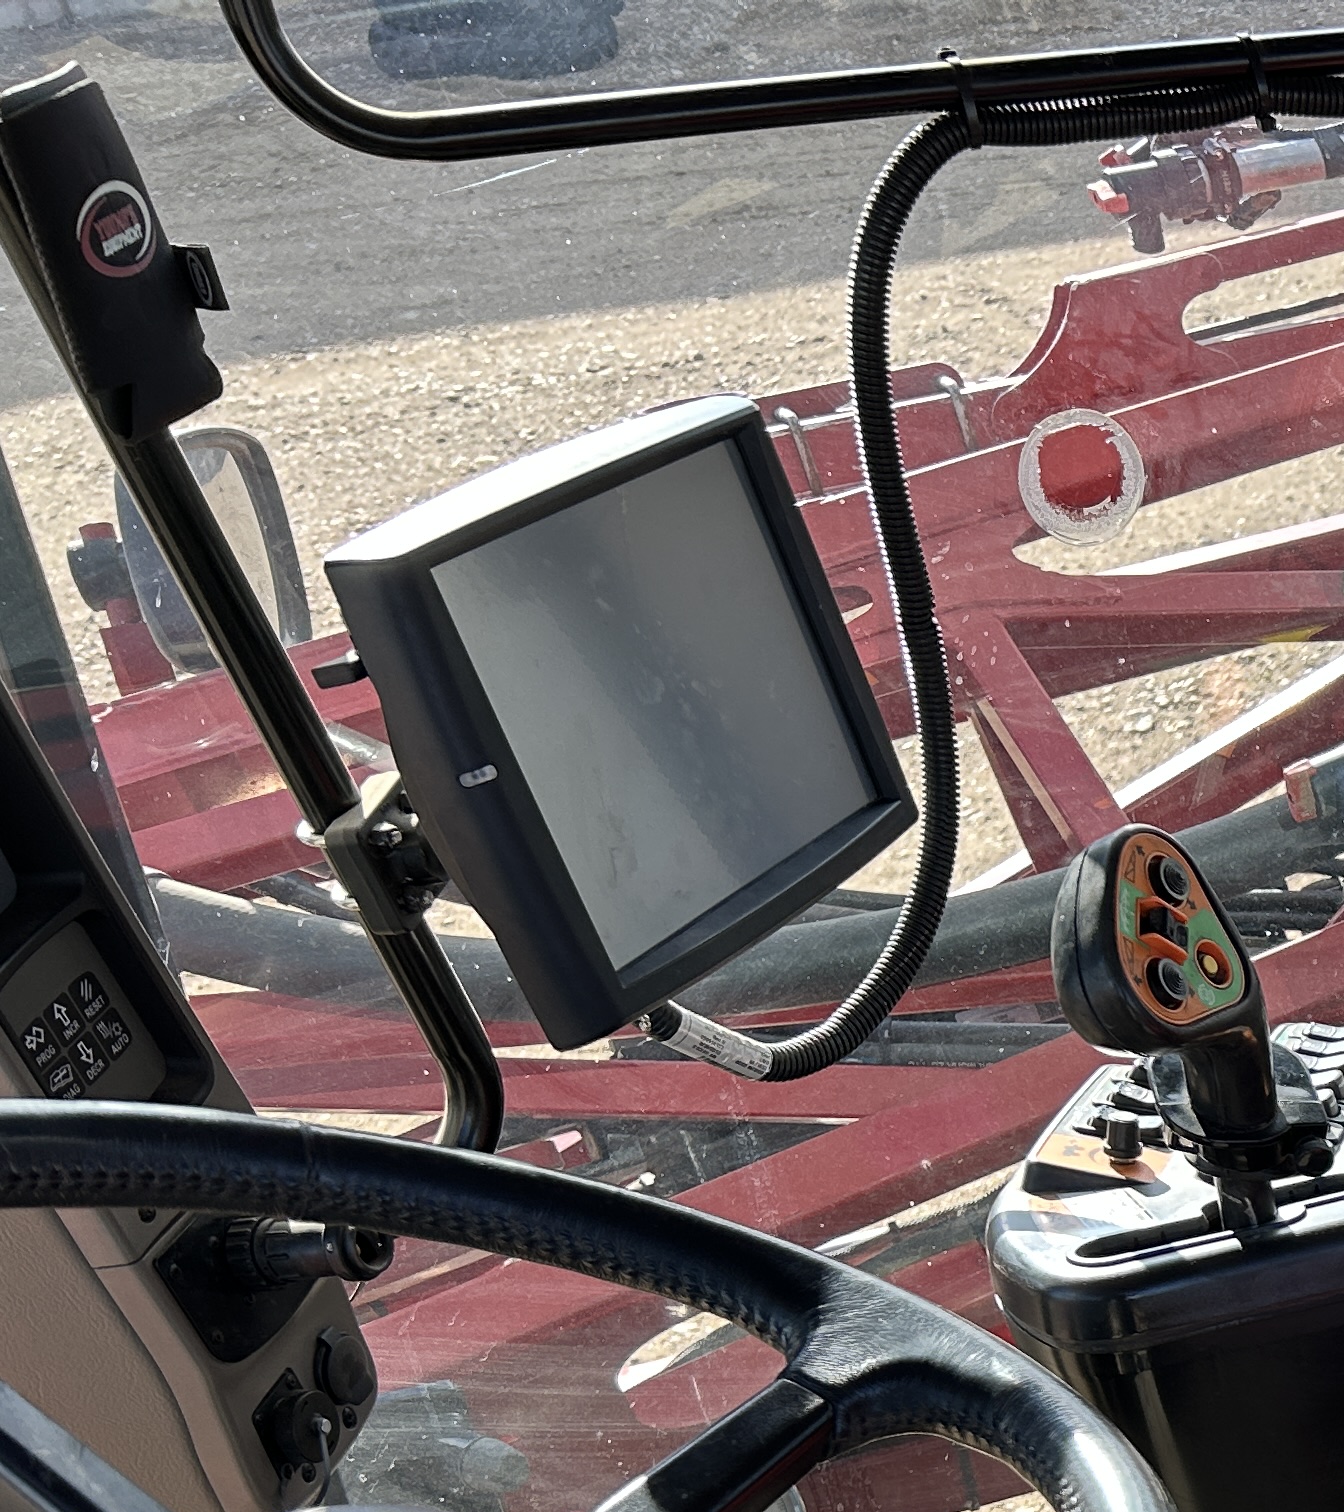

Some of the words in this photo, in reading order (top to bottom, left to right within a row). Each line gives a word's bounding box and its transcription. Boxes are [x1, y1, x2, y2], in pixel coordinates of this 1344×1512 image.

[83, 995, 106, 1019] RESET
[62, 1019, 81, 1041] INCR
[35, 1044, 56, 1067] PROG
[110, 1033, 130, 1055] AUTO
[85, 1058, 105, 1081] DECR
